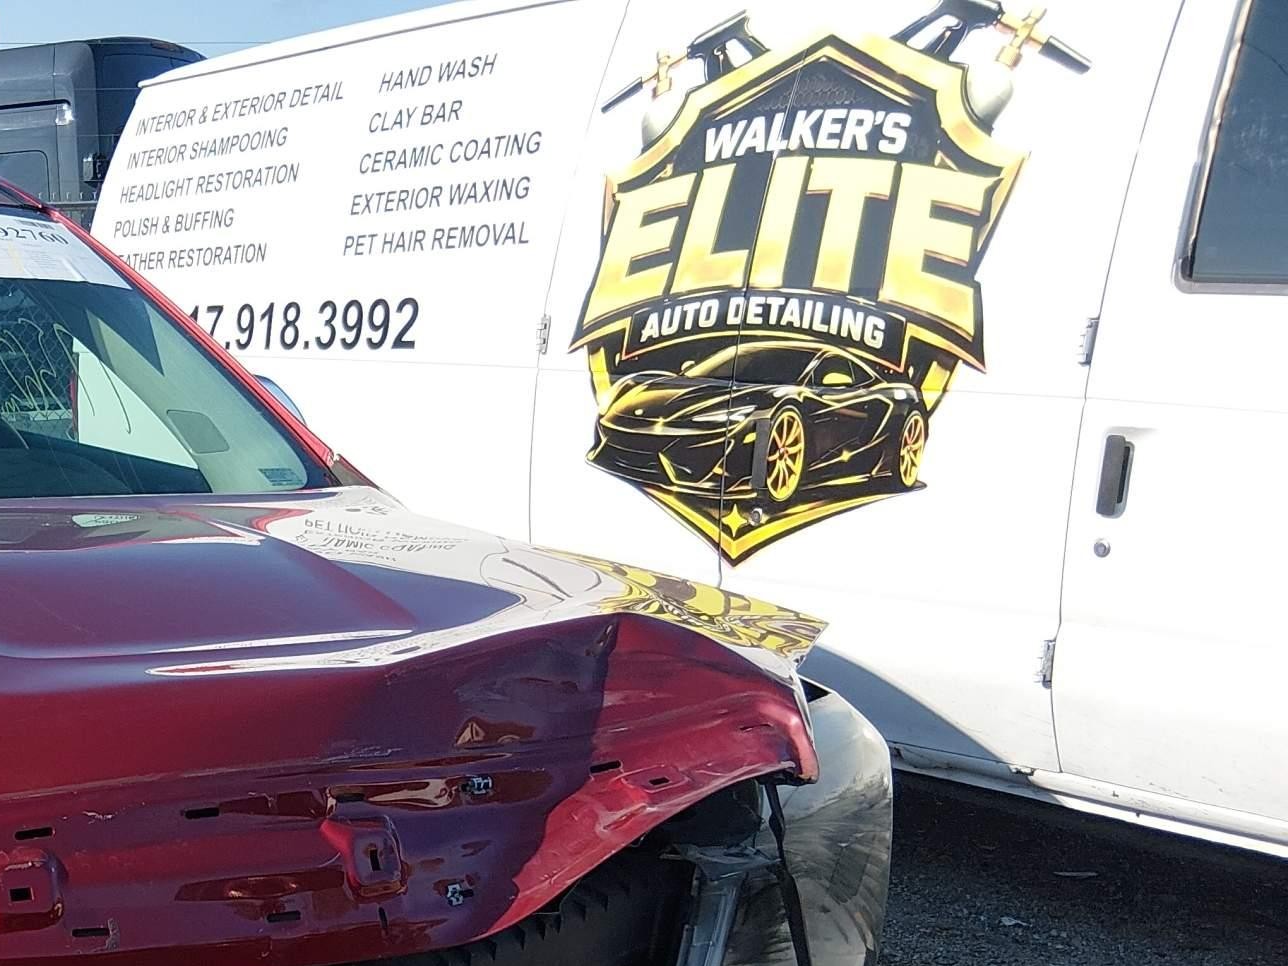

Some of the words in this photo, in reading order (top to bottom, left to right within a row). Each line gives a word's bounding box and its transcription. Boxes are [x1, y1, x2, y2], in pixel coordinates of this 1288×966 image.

[379, 65, 432, 94] HAND
[437, 53, 498, 83] WASH
[136, 109, 196, 136] INTERIOR
[198, 106, 209, 125] &
[212, 92, 286, 122] EXTERIOR
[289, 82, 344, 108] DETAIL
[368, 107, 417, 133] CLAY
[420, 100, 463, 125] BAR
[127, 144, 186, 169] INTERIOR
[190, 127, 289, 161] SHAMPOOING
[359, 143, 443, 174] CERAMIC
[449, 131, 543, 163] COATING
[704, 108, 912, 163] WALKER'S
[120, 177, 193, 204] HEADLIGHT
[196, 162, 299, 195] RESTORATION
[350, 185, 442, 216] EXTERIOR
[449, 176, 530, 205] WAXING
[114, 216, 158, 238] POLISH
[161, 215, 170, 233] &
[175, 208, 234, 232] BUFFING
[343, 233, 378, 256] PET
[382, 229, 427, 254] HAIR
[431, 221, 529, 250] REMOVAL
[167, 243, 267, 269] RESTORATION
[585, 156, 1002, 337] ELITE
[640, 300, 719, 342] AUTO
[726, 296, 886, 348] DETAILING
